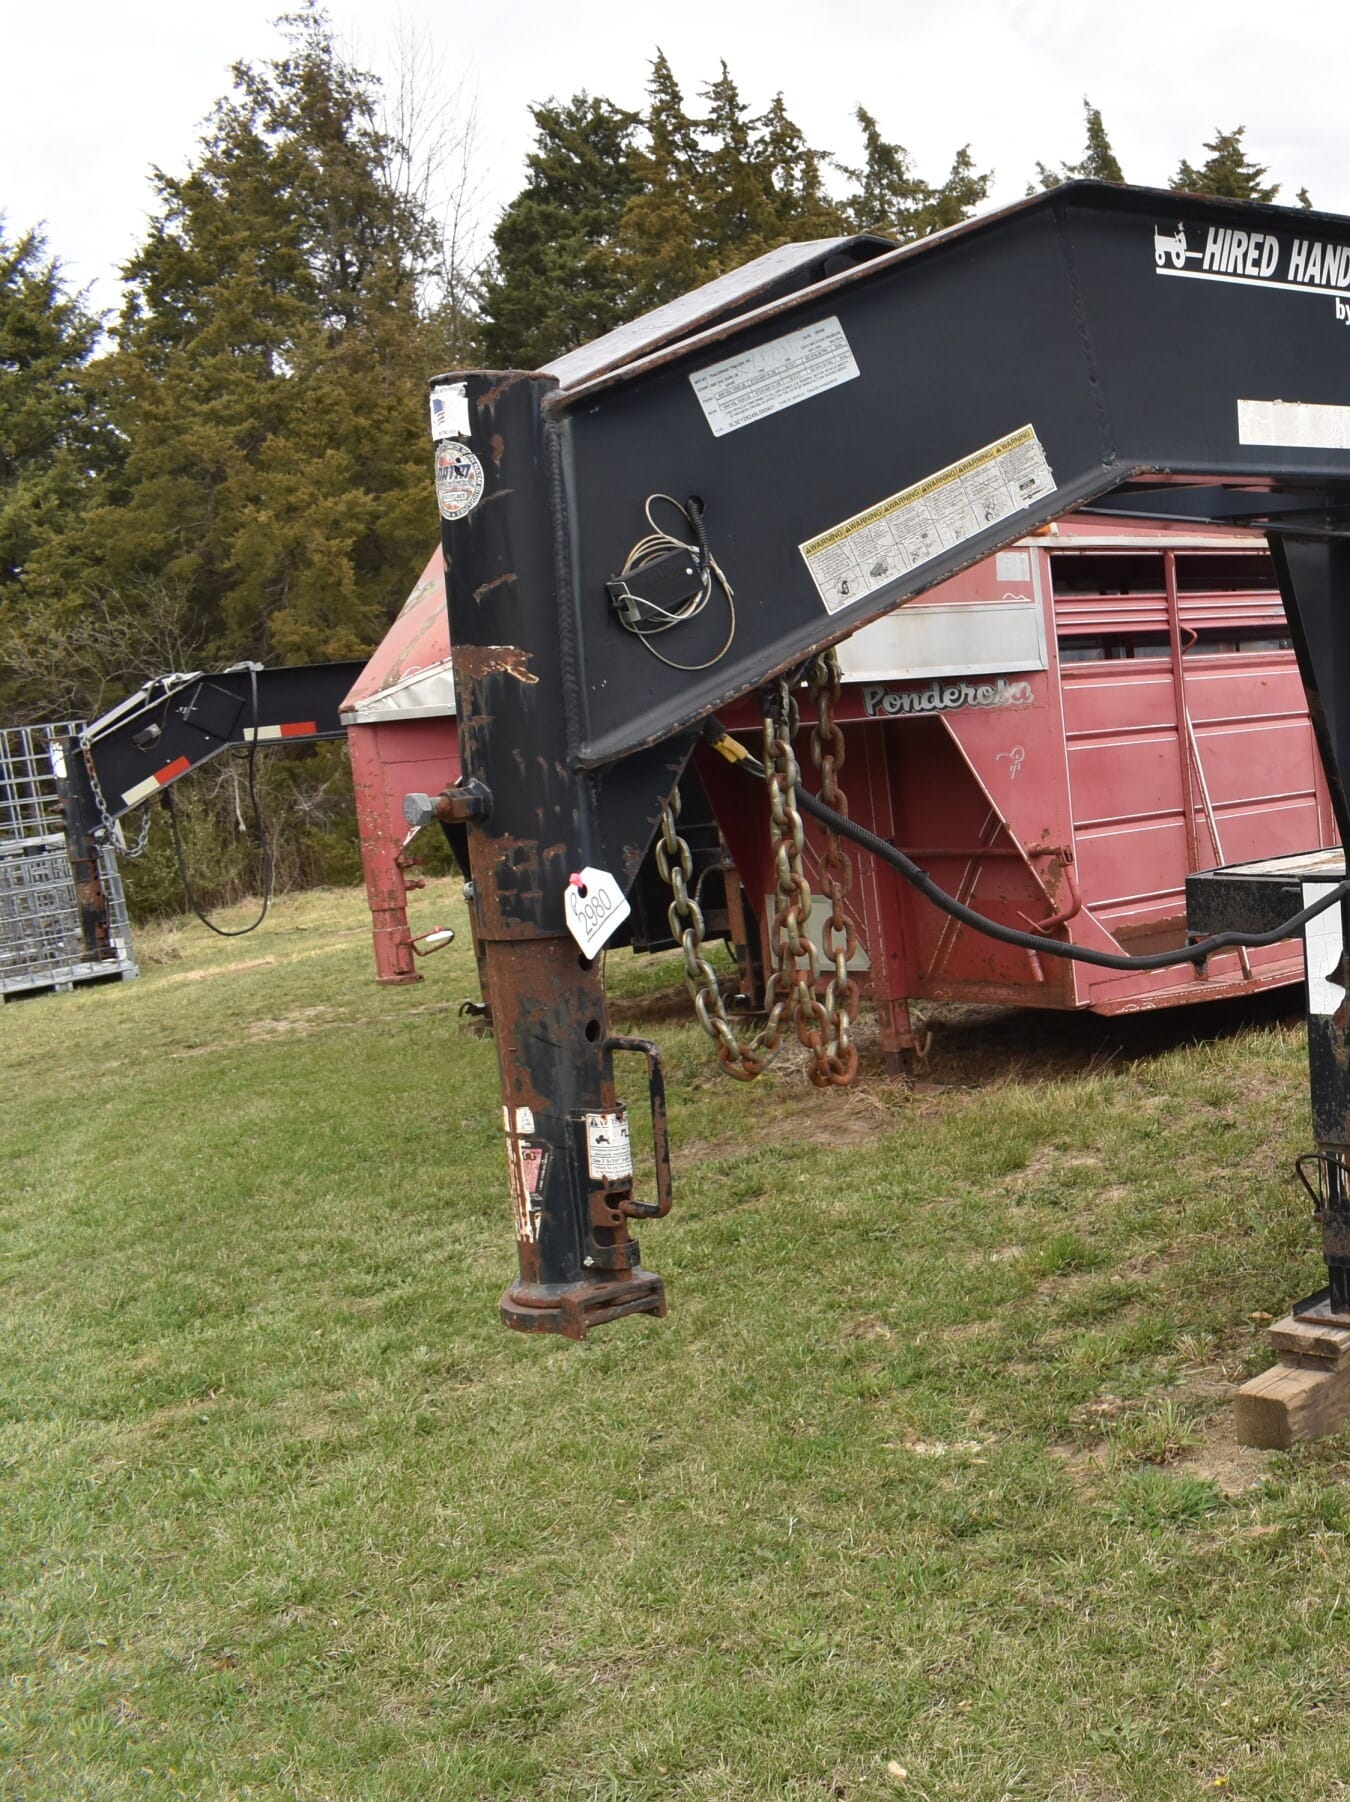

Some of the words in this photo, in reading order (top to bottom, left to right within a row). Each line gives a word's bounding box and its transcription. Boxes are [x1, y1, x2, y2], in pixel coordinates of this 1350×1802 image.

[1202, 226, 1280, 278] HIRED
[1000, 430, 1030, 451] WARNING
[961, 450, 992, 471] WARNING
[924, 469, 957, 491] WARNING
[887, 488, 920, 510] WARNING
[848, 508, 882, 531] WARNING
[809, 528, 843, 551] WARNING
[578, 888, 612, 936] 2980
